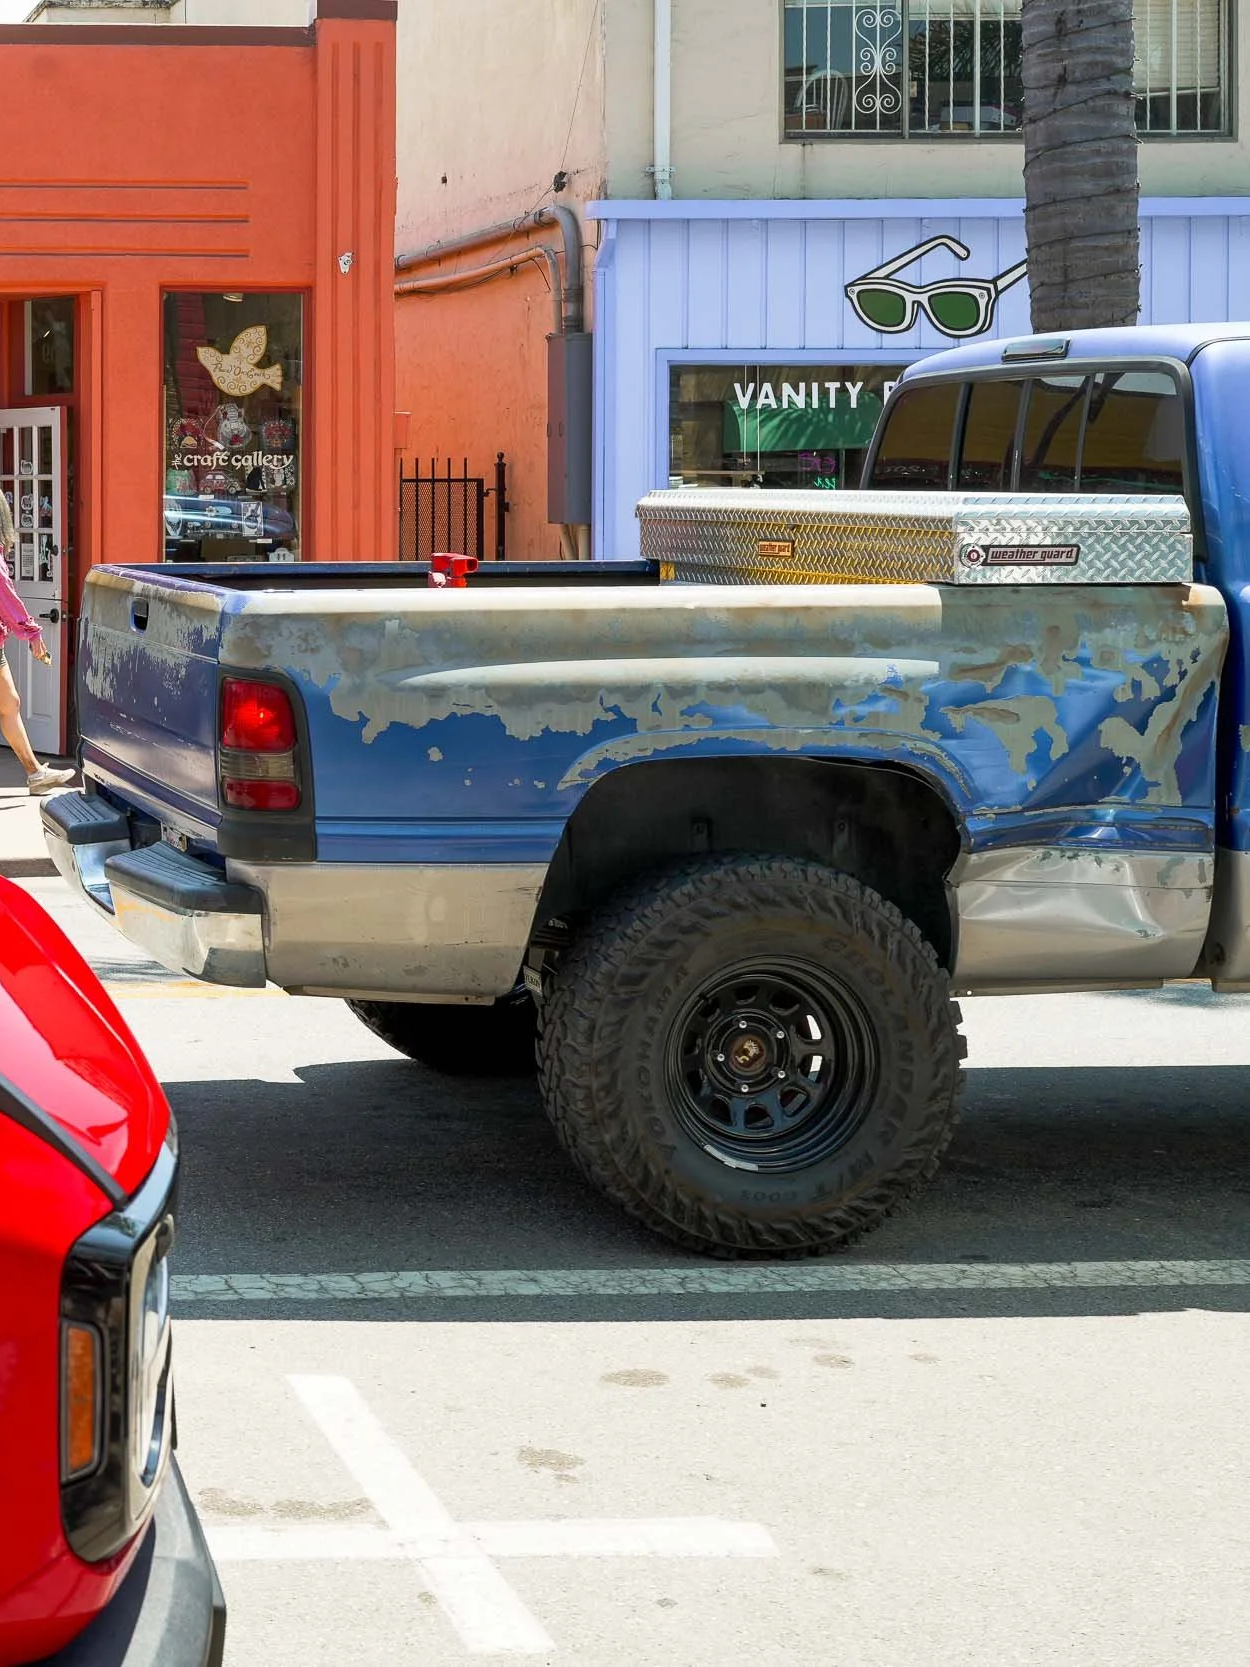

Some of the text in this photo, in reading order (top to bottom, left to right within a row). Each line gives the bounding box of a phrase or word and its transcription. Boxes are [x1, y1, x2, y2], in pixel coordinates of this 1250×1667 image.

[733, 381, 864, 409] VANITY
[171, 450, 294, 470] the craft gallery
[990, 548, 1075, 561] weather guard
[636, 963, 689, 1162] YOKOHAMA
